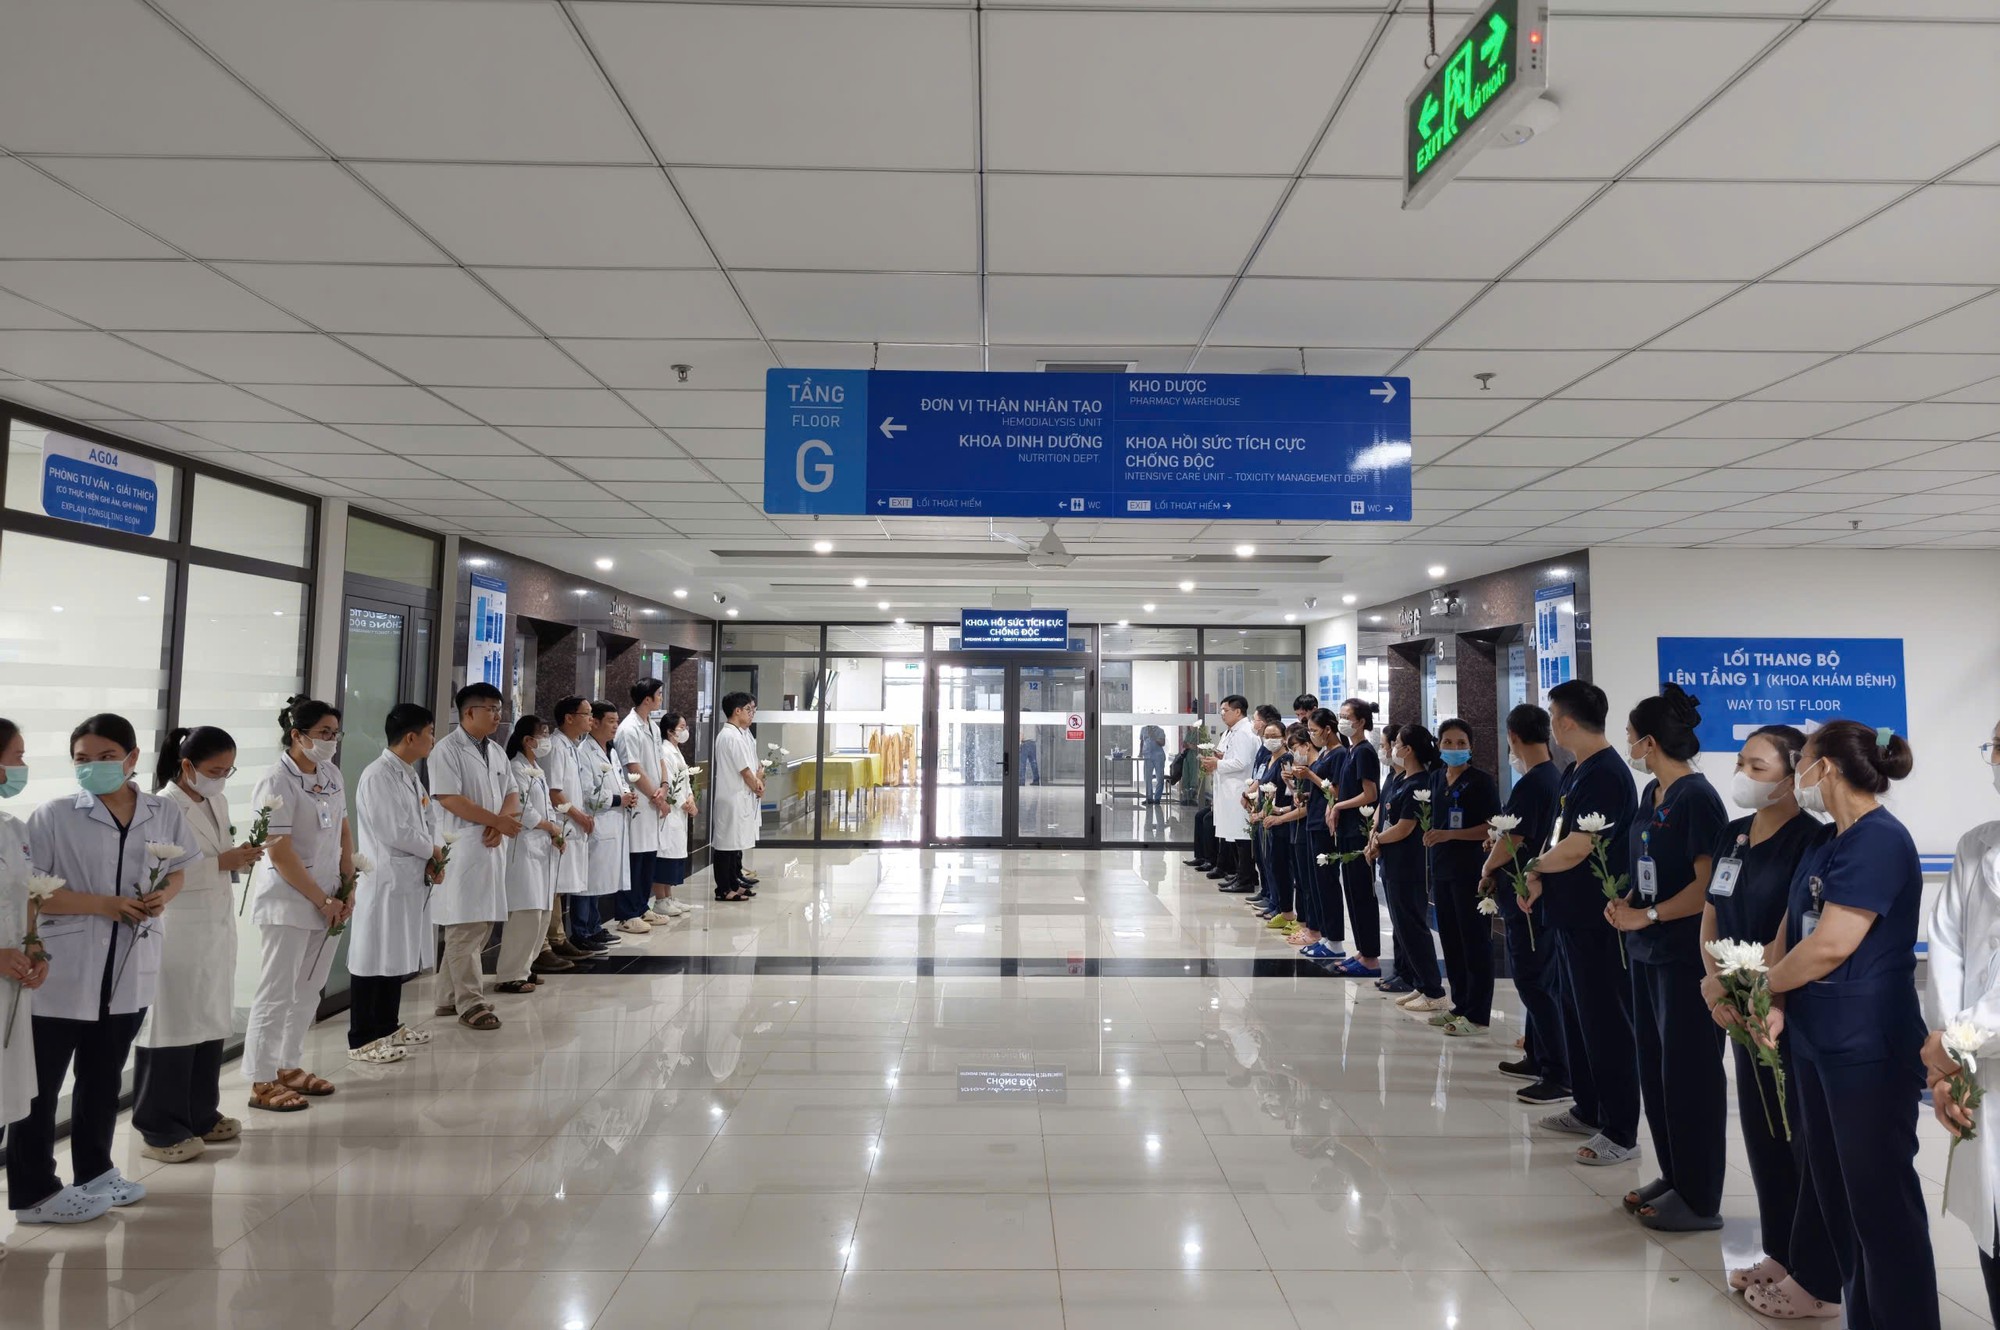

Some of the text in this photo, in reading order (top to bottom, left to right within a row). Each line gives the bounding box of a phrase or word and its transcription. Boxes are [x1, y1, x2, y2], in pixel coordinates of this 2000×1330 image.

[1416, 127, 1444, 173] EXIT
[787, 377, 845, 403] TẦNG
[1129, 380, 1207, 394] KHO DƯỢC
[921, 397, 1102, 415] ĐƠN VỊ THẬN NHÂN TẠO
[1130, 397, 1240, 406] PHARMACY WAREHOUSE
[792, 415, 840, 427] FLOOR
[1002, 417, 1102, 427] HEMODIALYSIS UNIT
[959, 433, 1102, 449] KHOA DINH DƯỠNG
[1126, 433, 1306, 453] KHOA HỒI SỨC TÍCH CỰC
[88, 448, 119, 467] AG04
[1018, 454, 1070, 463] NUTRITION
[1126, 452, 1214, 470] CHỐNG ĐỘC
[795, 439, 835, 493] G
[1125, 472, 1174, 480] INTENSIVE
[1176, 472, 1201, 481] CARE
[1203, 473, 1225, 481] UNIT
[1235, 473, 1275, 482] TOXICITY
[1277, 473, 1342, 482] MANAGEMENT
[80, 474, 92, 486] TƯ
[132, 488, 154, 502] THÍCH
[61, 501, 87, 514] EXPLAIN
[891, 498, 909, 507] EXIT
[933, 498, 958, 507] THOÁT
[1088, 501, 1101, 509] WC
[1129, 501, 1149, 509] EXIT
[1170, 501, 1198, 510] THOÁT
[1367, 504, 1381, 512] WC
[1021, 627, 1039, 637] ĐỘC
[1528, 628, 1536, 650] 4
[1438, 641, 1445, 661] 5
[1723, 648, 1840, 670] LỐI THANG BỘ
[1669, 666, 1897, 689] LÊN TẦNG 1 (KHOA KHÁM BỆNH)
[1028, 682, 1038, 690] 12
[1121, 683, 1129, 691] 11
[1727, 700, 1841, 711] WAY TO 1ST FLOOR
